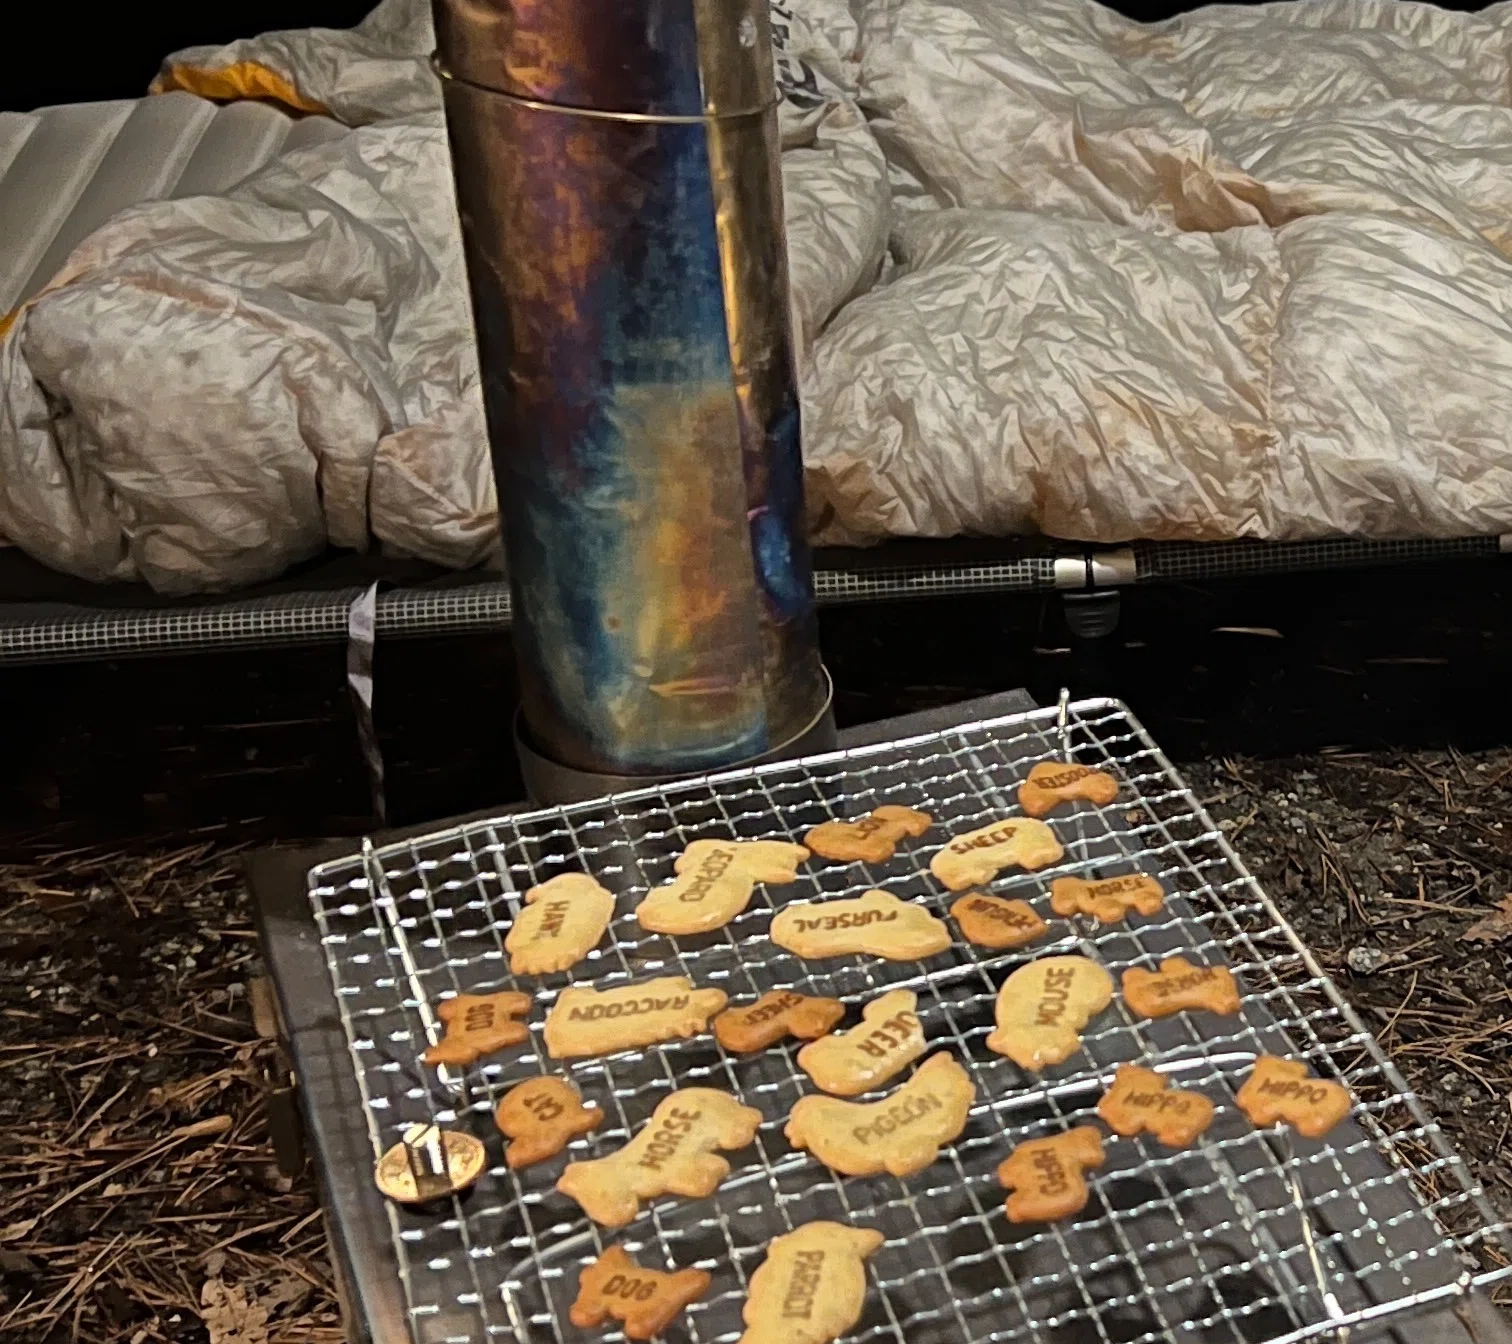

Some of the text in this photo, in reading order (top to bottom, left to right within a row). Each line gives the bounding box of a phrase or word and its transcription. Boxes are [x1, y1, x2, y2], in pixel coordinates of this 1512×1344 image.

[950, 826, 1018, 855] SHEEP
[793, 908, 898, 933] FURSEAL
[567, 993, 690, 1022] RACCOON
[1034, 966, 1075, 1027] MOUSE
[1122, 1090, 1191, 1115] HIPPO
[1254, 1077, 1329, 1106] HIPPO
[523, 1092, 565, 1122] CAT
[852, 1091, 944, 1145] PIGEON
[638, 1106, 702, 1171] HORSE
[602, 1274, 657, 1302] DOG
[782, 1248, 825, 1320] PARROT
